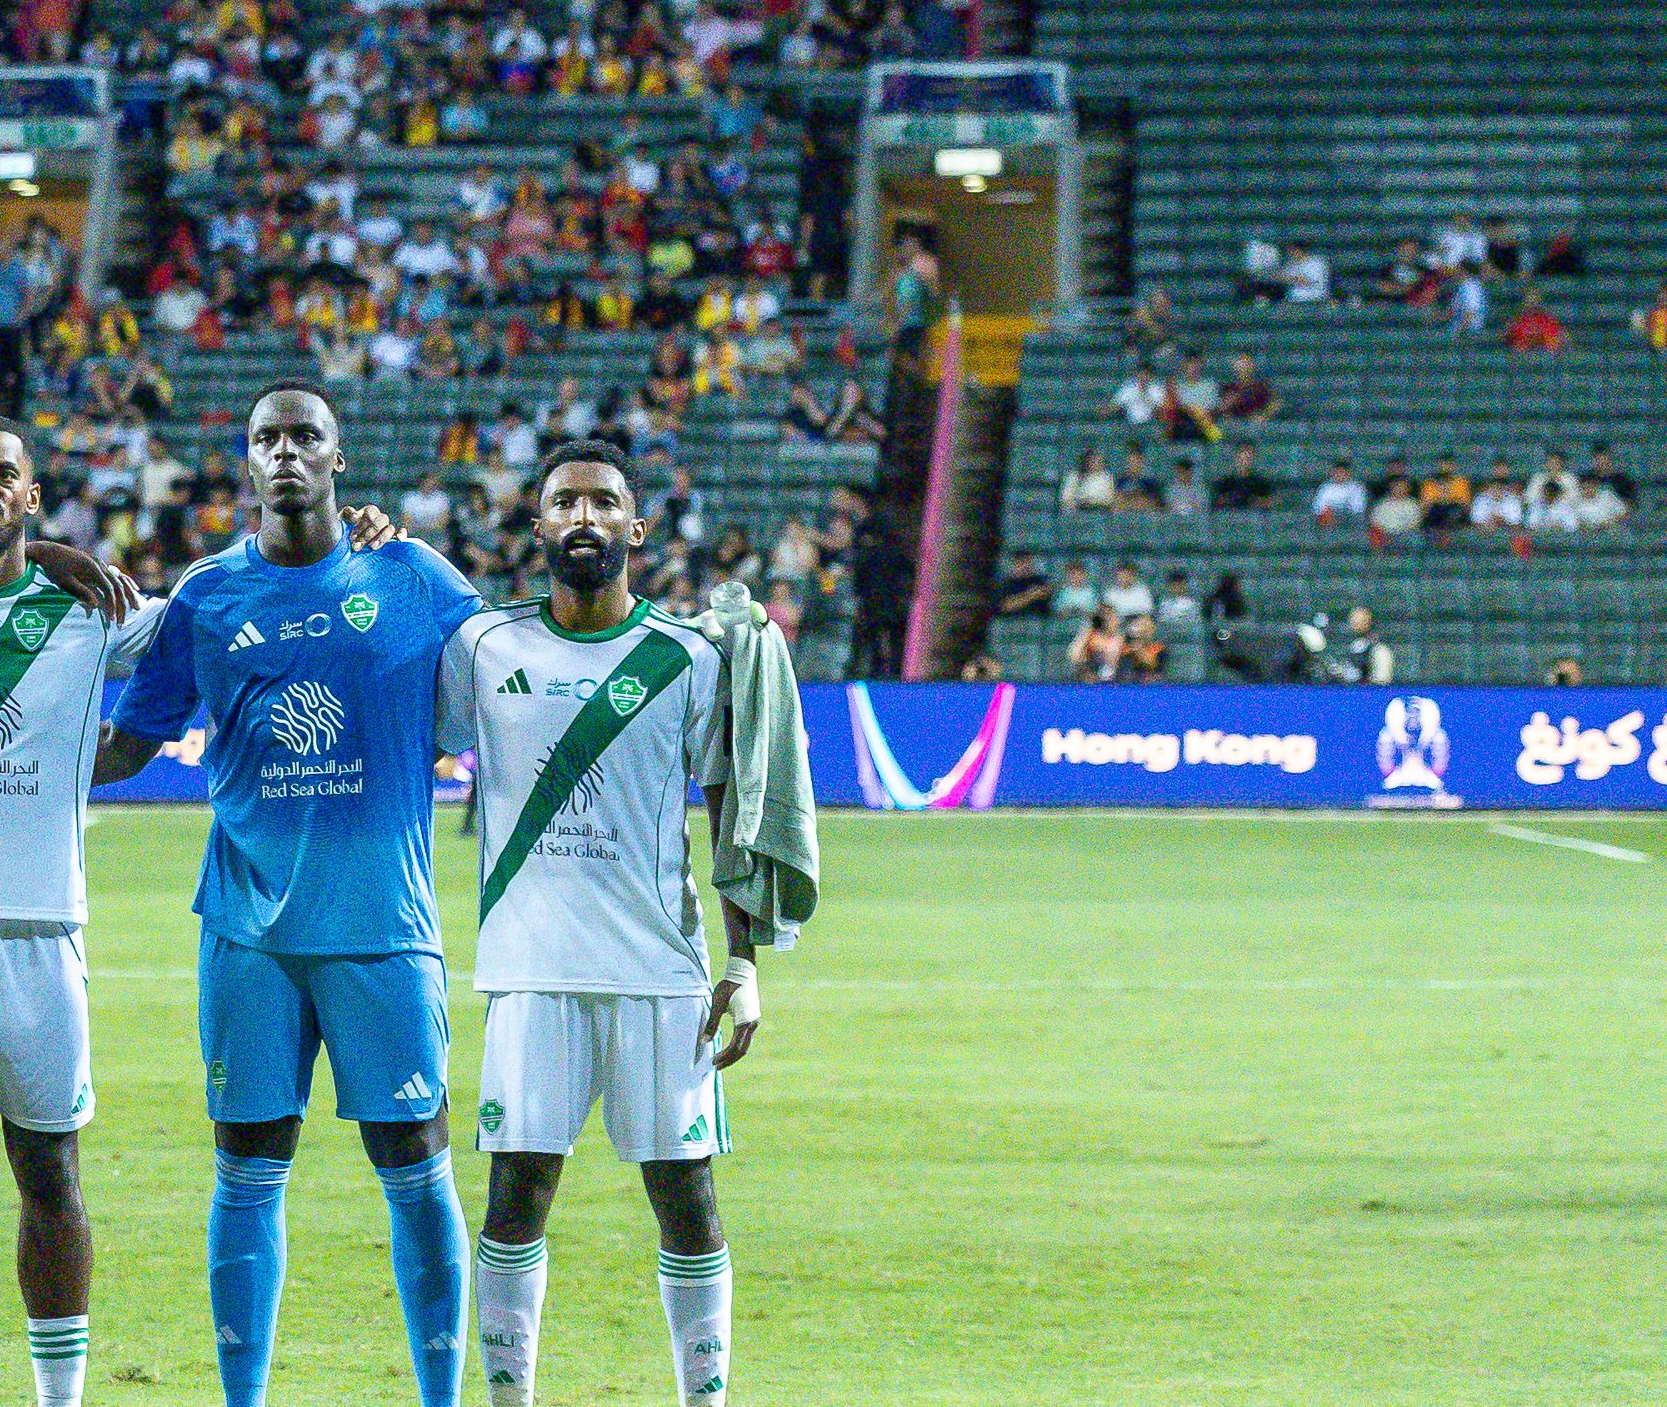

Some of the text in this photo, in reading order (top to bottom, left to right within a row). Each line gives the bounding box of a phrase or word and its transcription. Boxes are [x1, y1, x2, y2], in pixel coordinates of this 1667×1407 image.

[279, 629, 304, 641] SIRC
[1041, 728, 1318, 773] Hong Kong
[1516, 711, 1645, 786] كونغ
[262, 778, 363, 799] Red Sea Global
[546, 842, 571, 857] Sea
[694, 1341, 723, 1355] AHL
